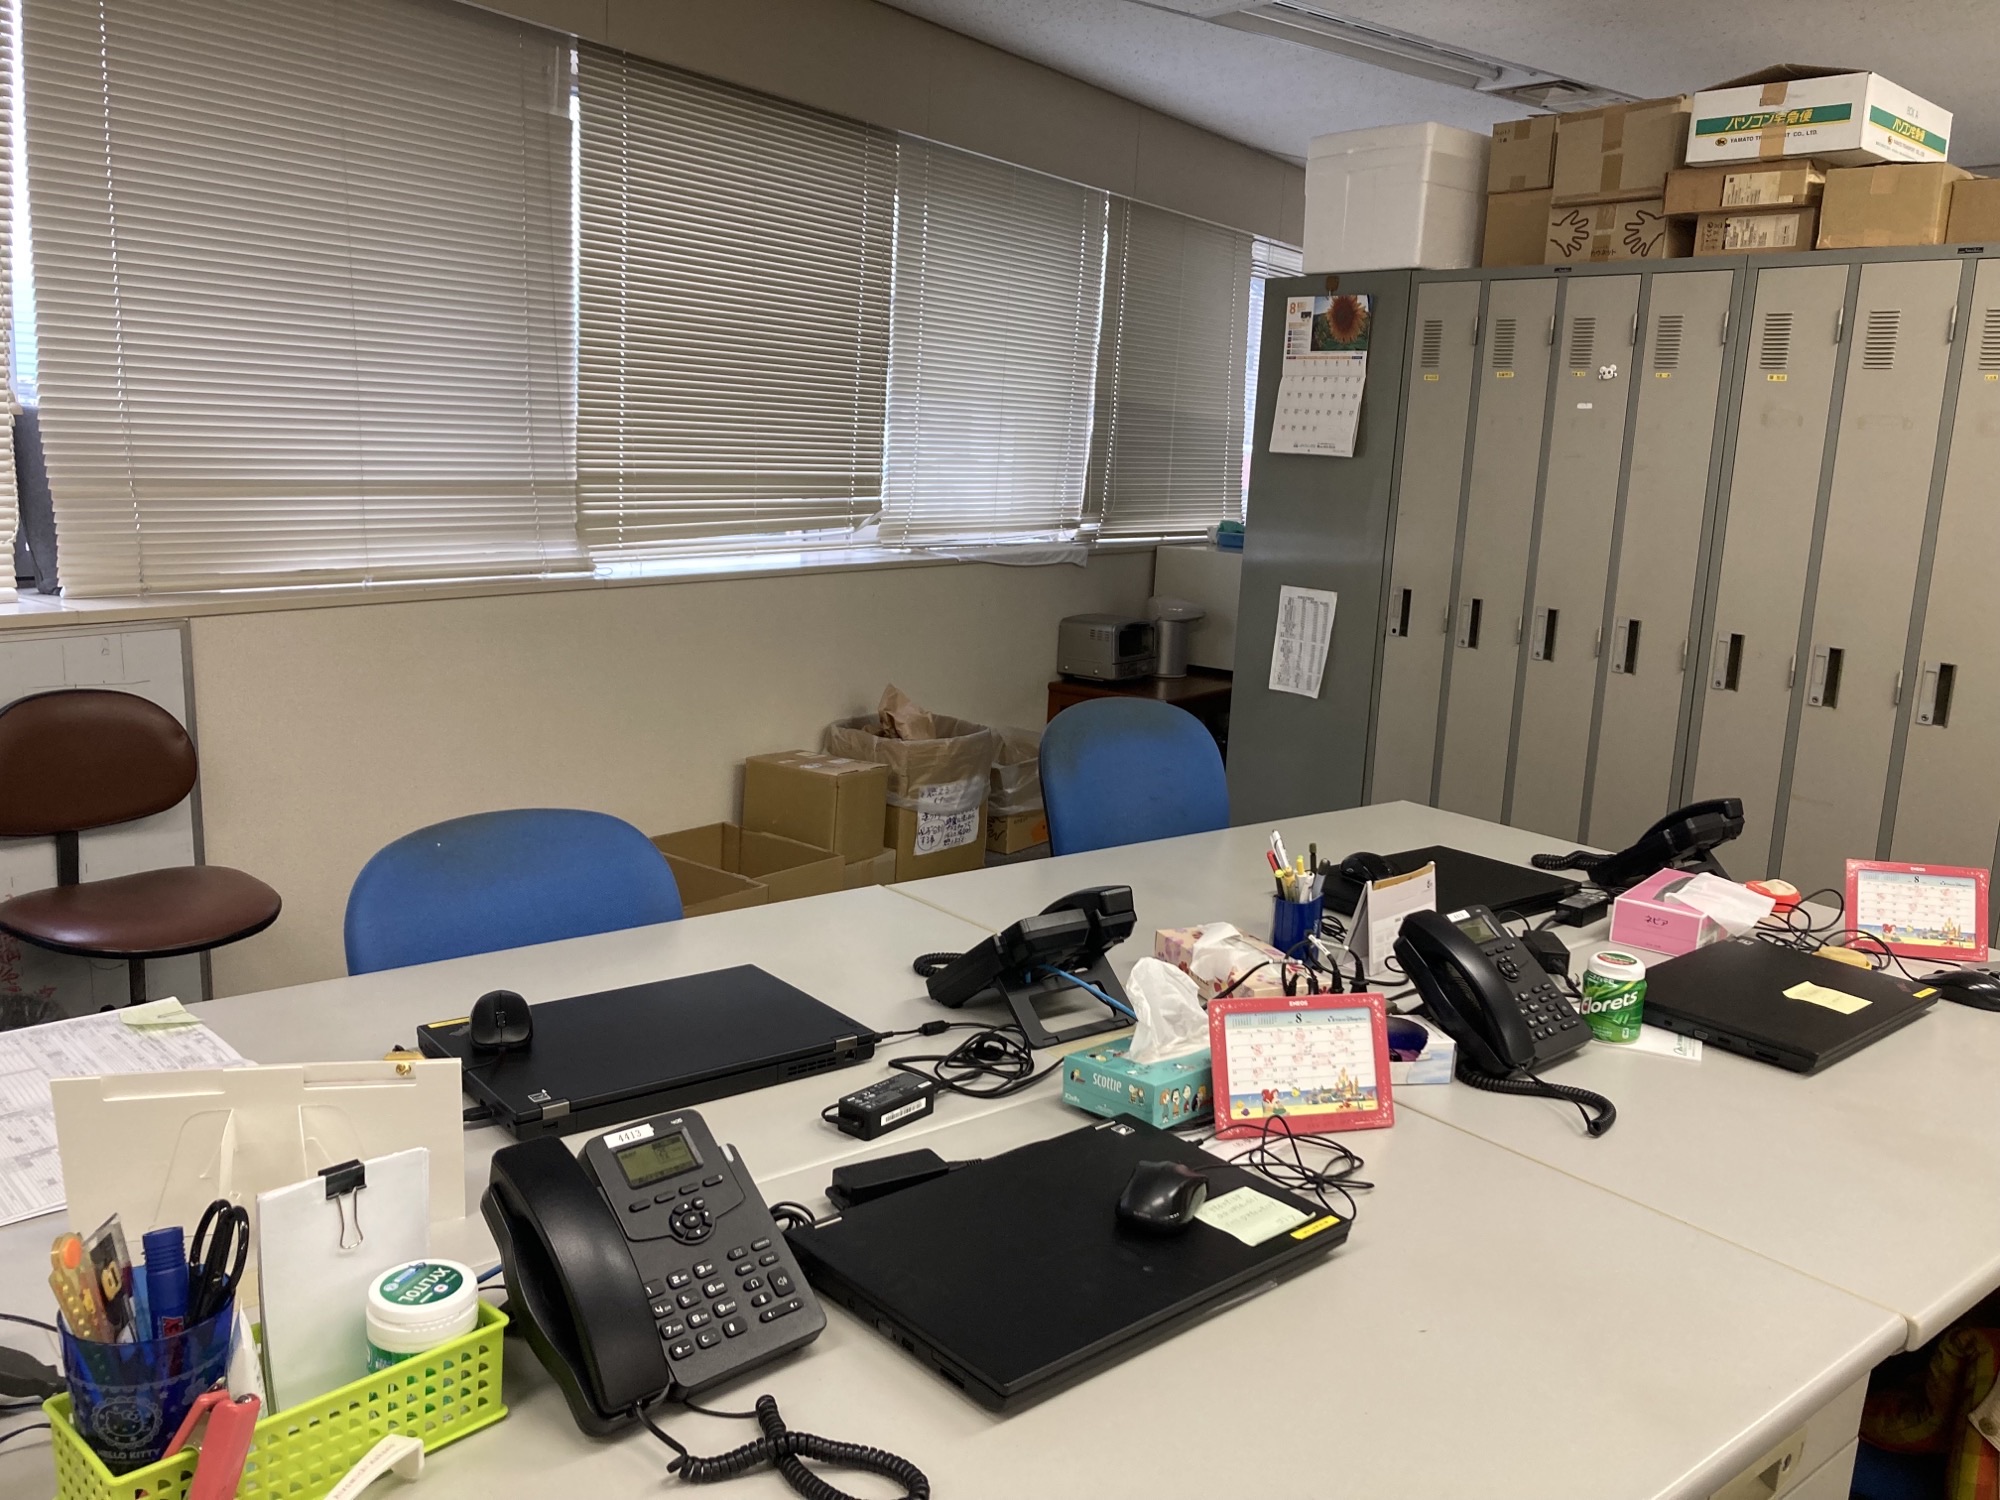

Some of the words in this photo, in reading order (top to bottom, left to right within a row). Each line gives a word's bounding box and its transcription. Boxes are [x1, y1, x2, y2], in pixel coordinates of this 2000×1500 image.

[1725, 109, 1814, 131] パソコン宅急便
[1730, 136, 1754, 144] YAMATO
[1289, 302, 1296, 314] 8
[1644, 915, 1669, 926] ネピア
[1581, 990, 1639, 1015] Clorets
[1295, 1012, 1303, 1025] 8
[1092, 1072, 1123, 1093] scottie
[618, 1129, 642, 1142] 4413
[397, 1266, 452, 1302] XYLITOL
[672, 1275, 681, 1284] 2
[696, 1264, 706, 1274] 3
[655, 1306, 664, 1314] 4
[707, 1284, 716, 1293] 6
[666, 1325, 673, 1335] 7
[692, 1314, 700, 1323] 8
[718, 1303, 726, 1312] 9
[129, 1448, 161, 1459] KITTY
